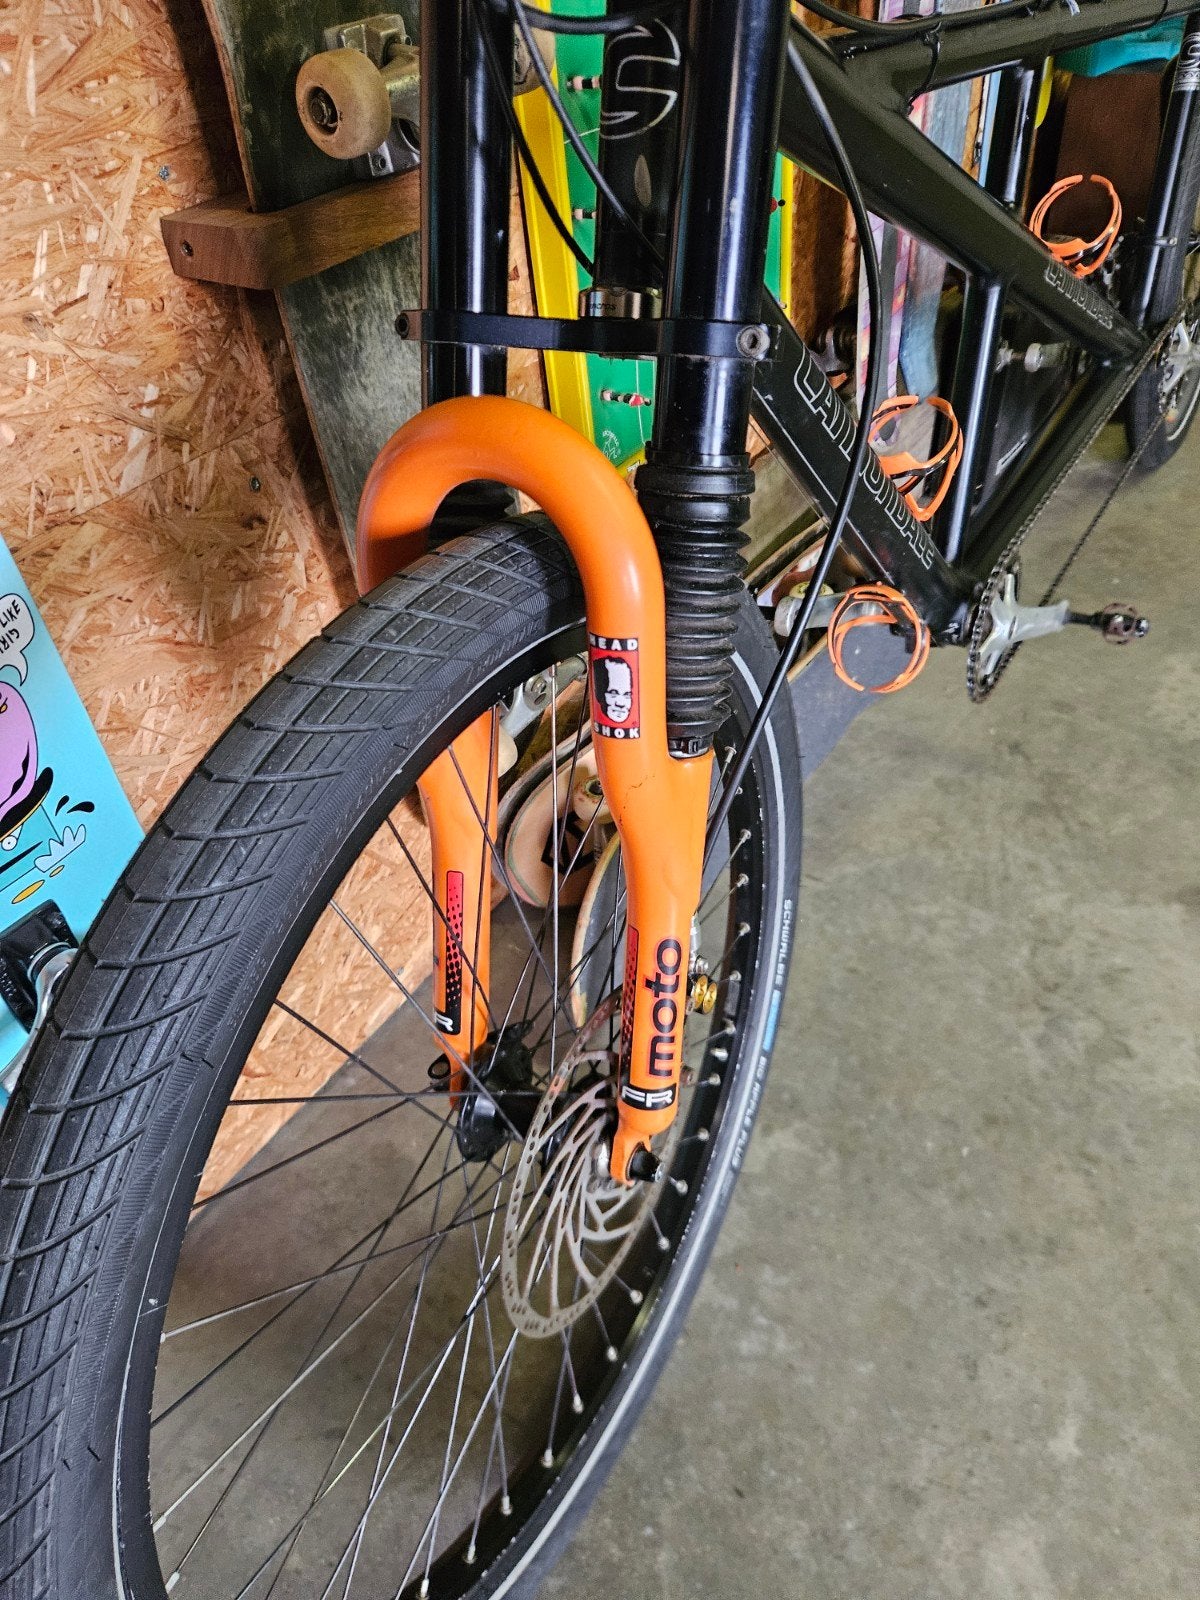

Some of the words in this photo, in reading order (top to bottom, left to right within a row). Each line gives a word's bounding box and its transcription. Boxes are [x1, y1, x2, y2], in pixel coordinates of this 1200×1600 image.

[0, 599, 21, 629] LIKE
[589, 632, 639, 651] HEAD
[594, 721, 640, 739] SHOK
[775, 899, 793, 986] SCHWALBE
[645, 938, 682, 1078] moto
[622, 1085, 674, 1108] FR
